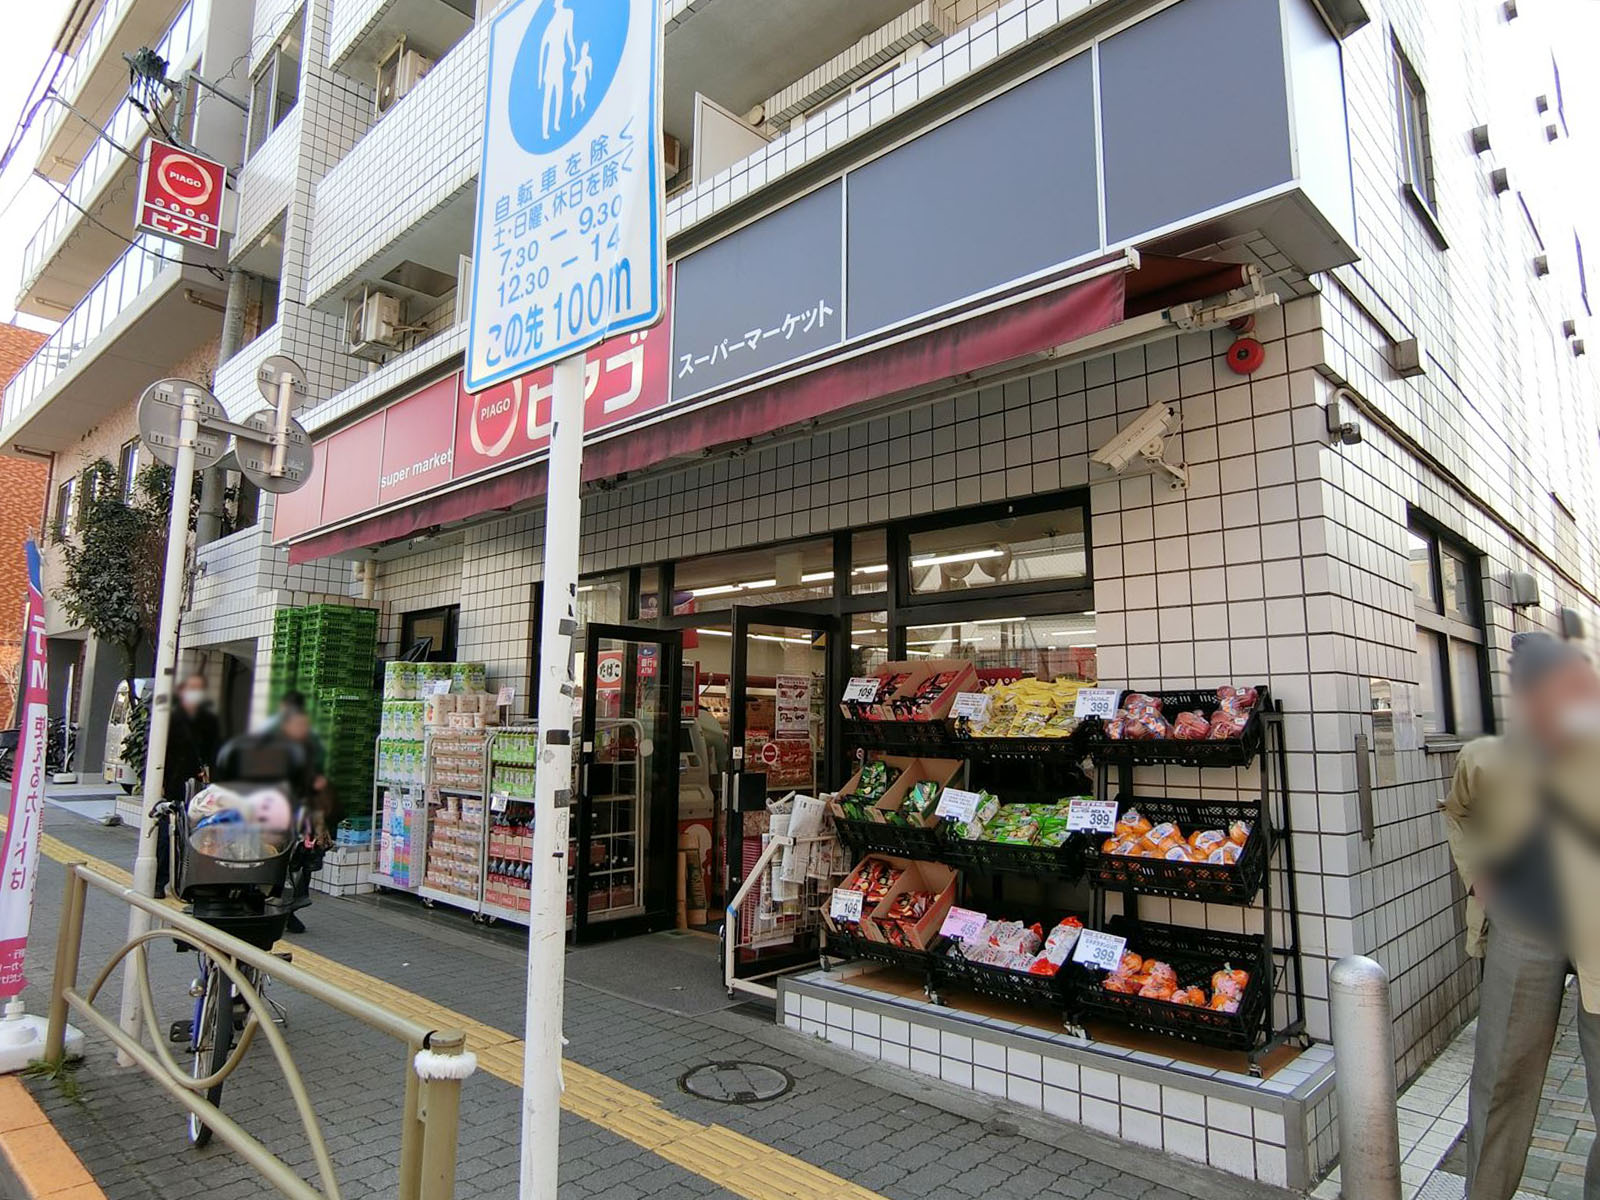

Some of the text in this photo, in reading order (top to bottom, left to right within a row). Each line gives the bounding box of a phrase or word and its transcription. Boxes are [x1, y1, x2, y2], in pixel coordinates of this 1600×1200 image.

[169, 171, 202, 188] PIAGO
[495, 116, 634, 222] 自転車を除く
[152, 211, 209, 243] ピアゴ
[501, 240, 539, 276] 7.30
[579, 194, 622, 235] 9.30
[497, 266, 549, 308] 12.30
[678, 299, 834, 379] スーパーマーケット
[480, 397, 511, 421] PIAGO
[380, 447, 453, 488] super market
[1091, 702, 1109, 712] 399
[1090, 813, 1110, 825] 399
[1093, 947, 1115, 962] 399
